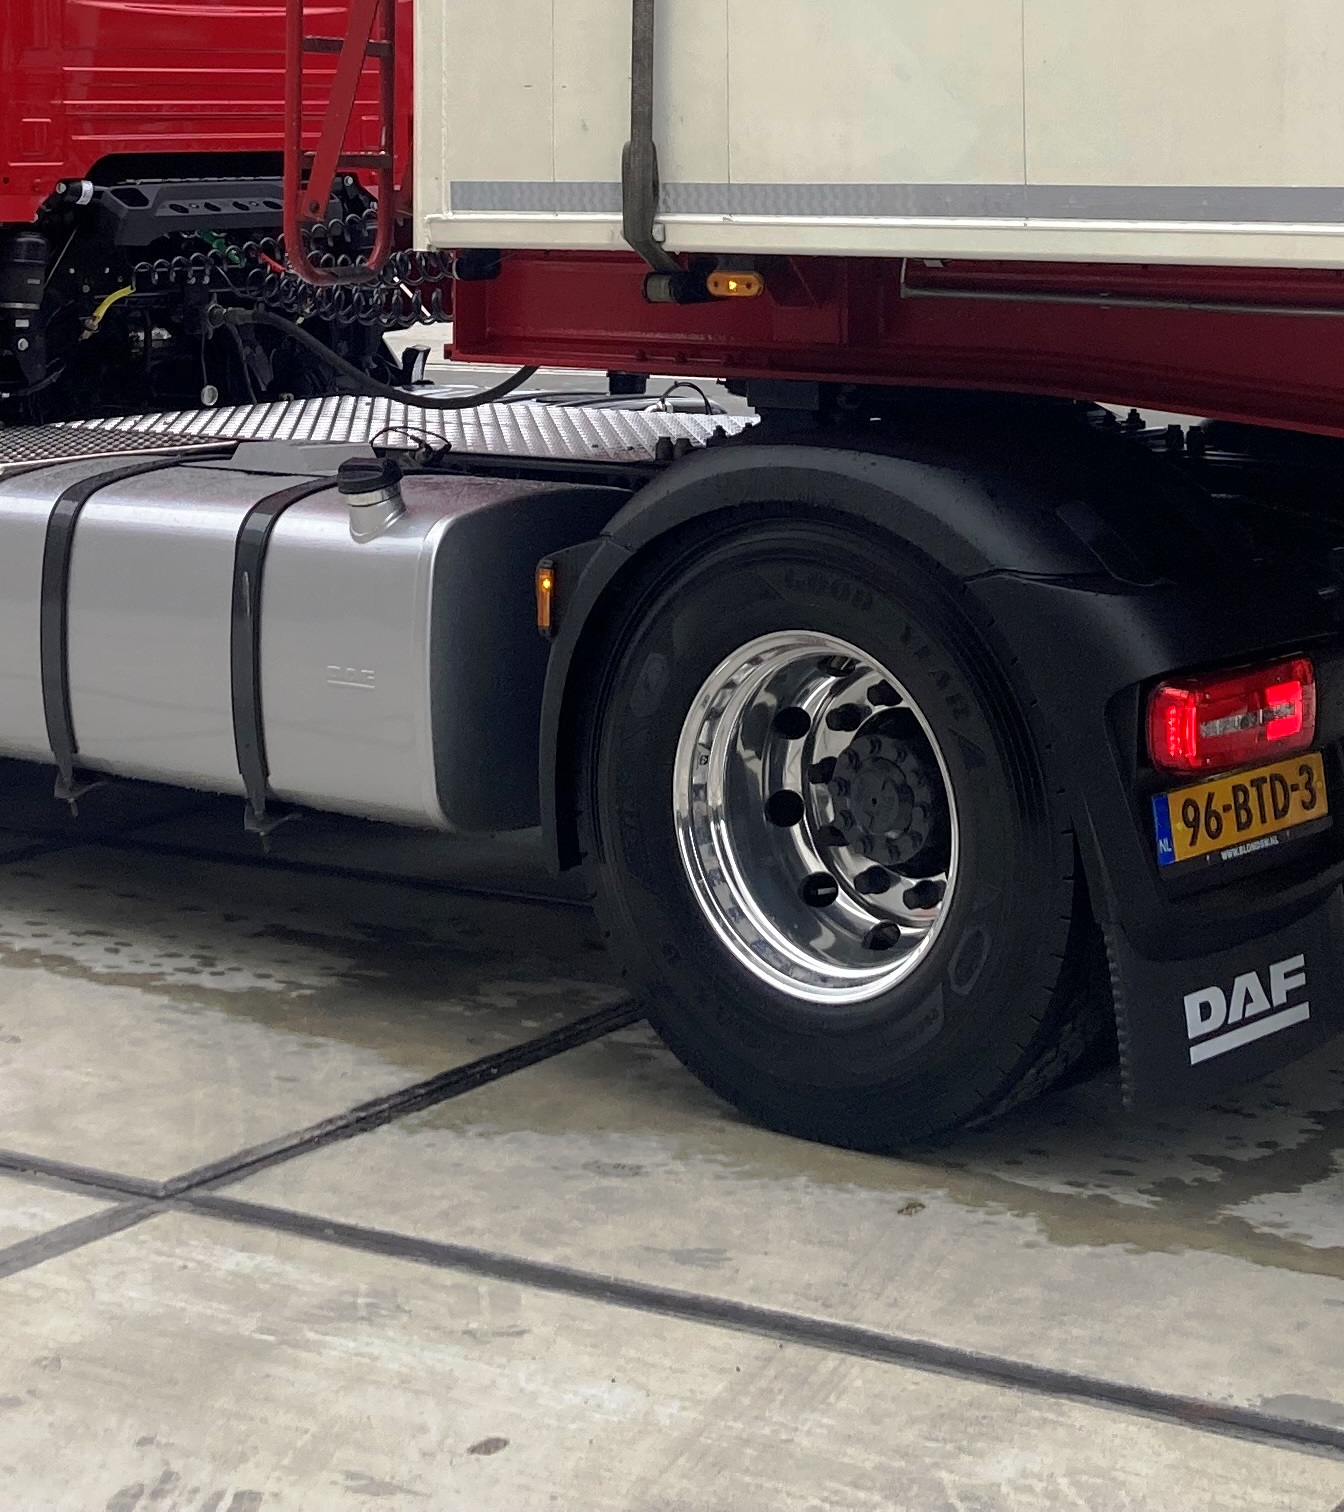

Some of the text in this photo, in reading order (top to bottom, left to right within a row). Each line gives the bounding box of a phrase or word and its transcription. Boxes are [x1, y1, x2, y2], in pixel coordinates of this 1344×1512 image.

[1159, 764, 1317, 853] NL 96-BTD-3
[1183, 954, 1306, 1040] DAF
